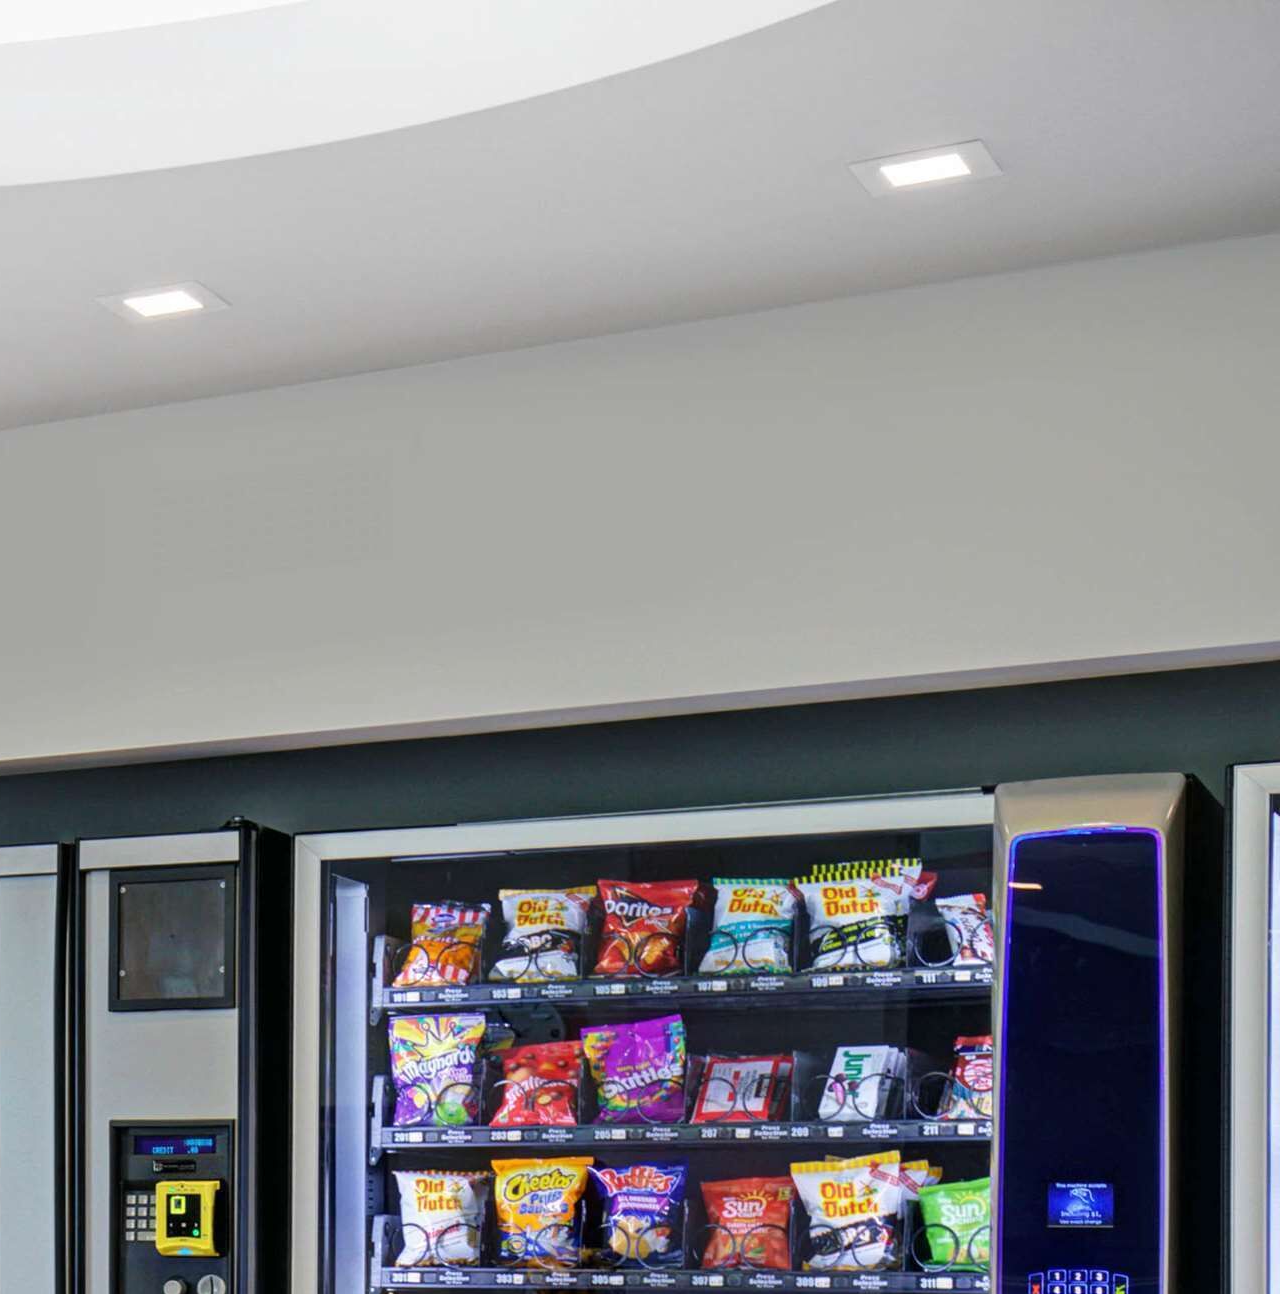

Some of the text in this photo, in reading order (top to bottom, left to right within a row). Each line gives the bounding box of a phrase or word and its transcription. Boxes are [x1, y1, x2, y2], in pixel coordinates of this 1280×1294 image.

[822, 886, 857, 899] Old
[518, 901, 549, 913] Old
[605, 899, 672, 918] Doritos
[728, 898, 779, 916] Dutch
[824, 901, 880, 917] Dutch
[516, 912, 566, 927] Dutch
[401, 1044, 476, 1080] Maynards
[603, 1063, 684, 1099] Skittles
[415, 1178, 444, 1193] Old
[504, 1169, 577, 1202] Cheetos
[600, 1166, 674, 1194] Ruffles
[820, 1182, 855, 1199] Old
[722, 1198, 767, 1219] Sun
[823, 1200, 879, 1218] Dutch
[941, 1204, 980, 1224] Sun
